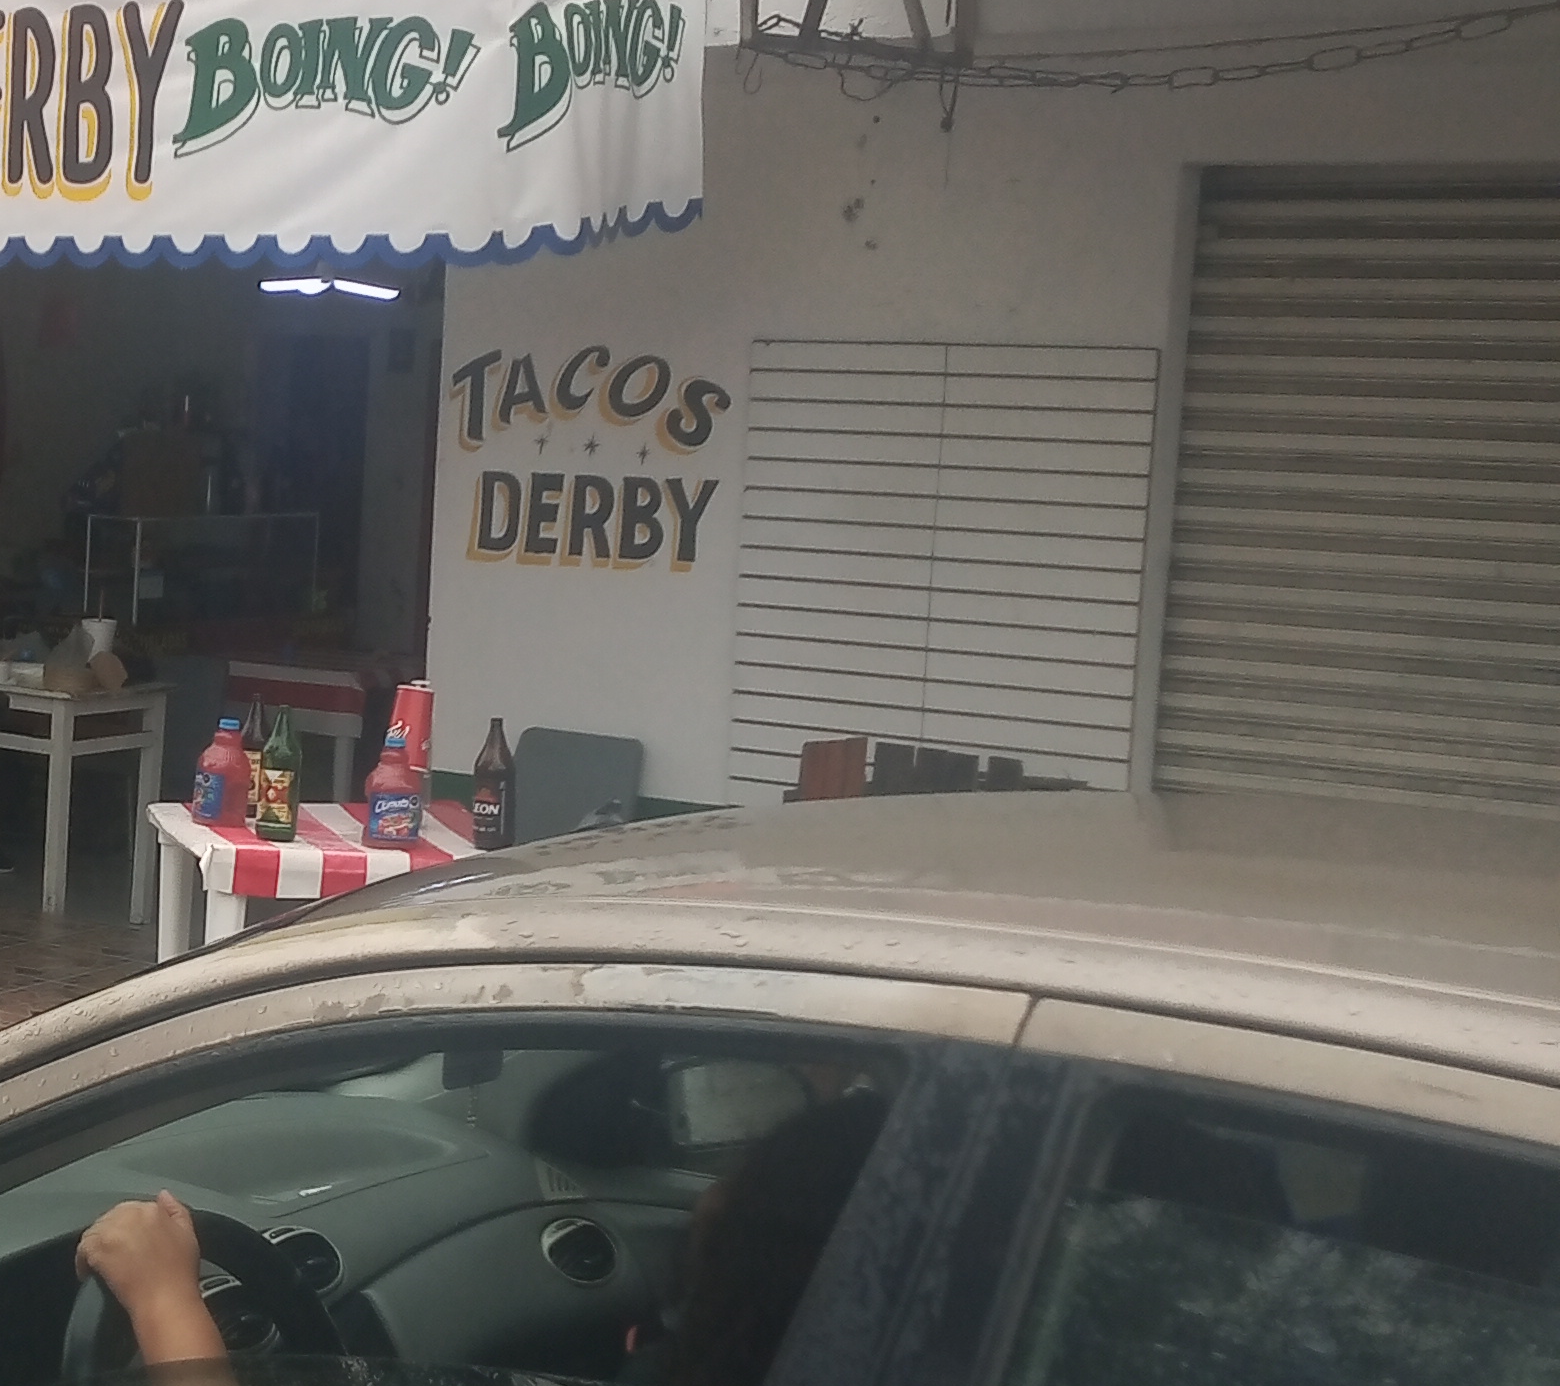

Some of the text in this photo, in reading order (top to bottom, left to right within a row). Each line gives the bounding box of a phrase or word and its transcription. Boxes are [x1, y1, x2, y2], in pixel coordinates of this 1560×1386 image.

[173, 16, 481, 158] BOING!
[452, 344, 733, 453] TACOS
[466, 470, 720, 574] DERBY
